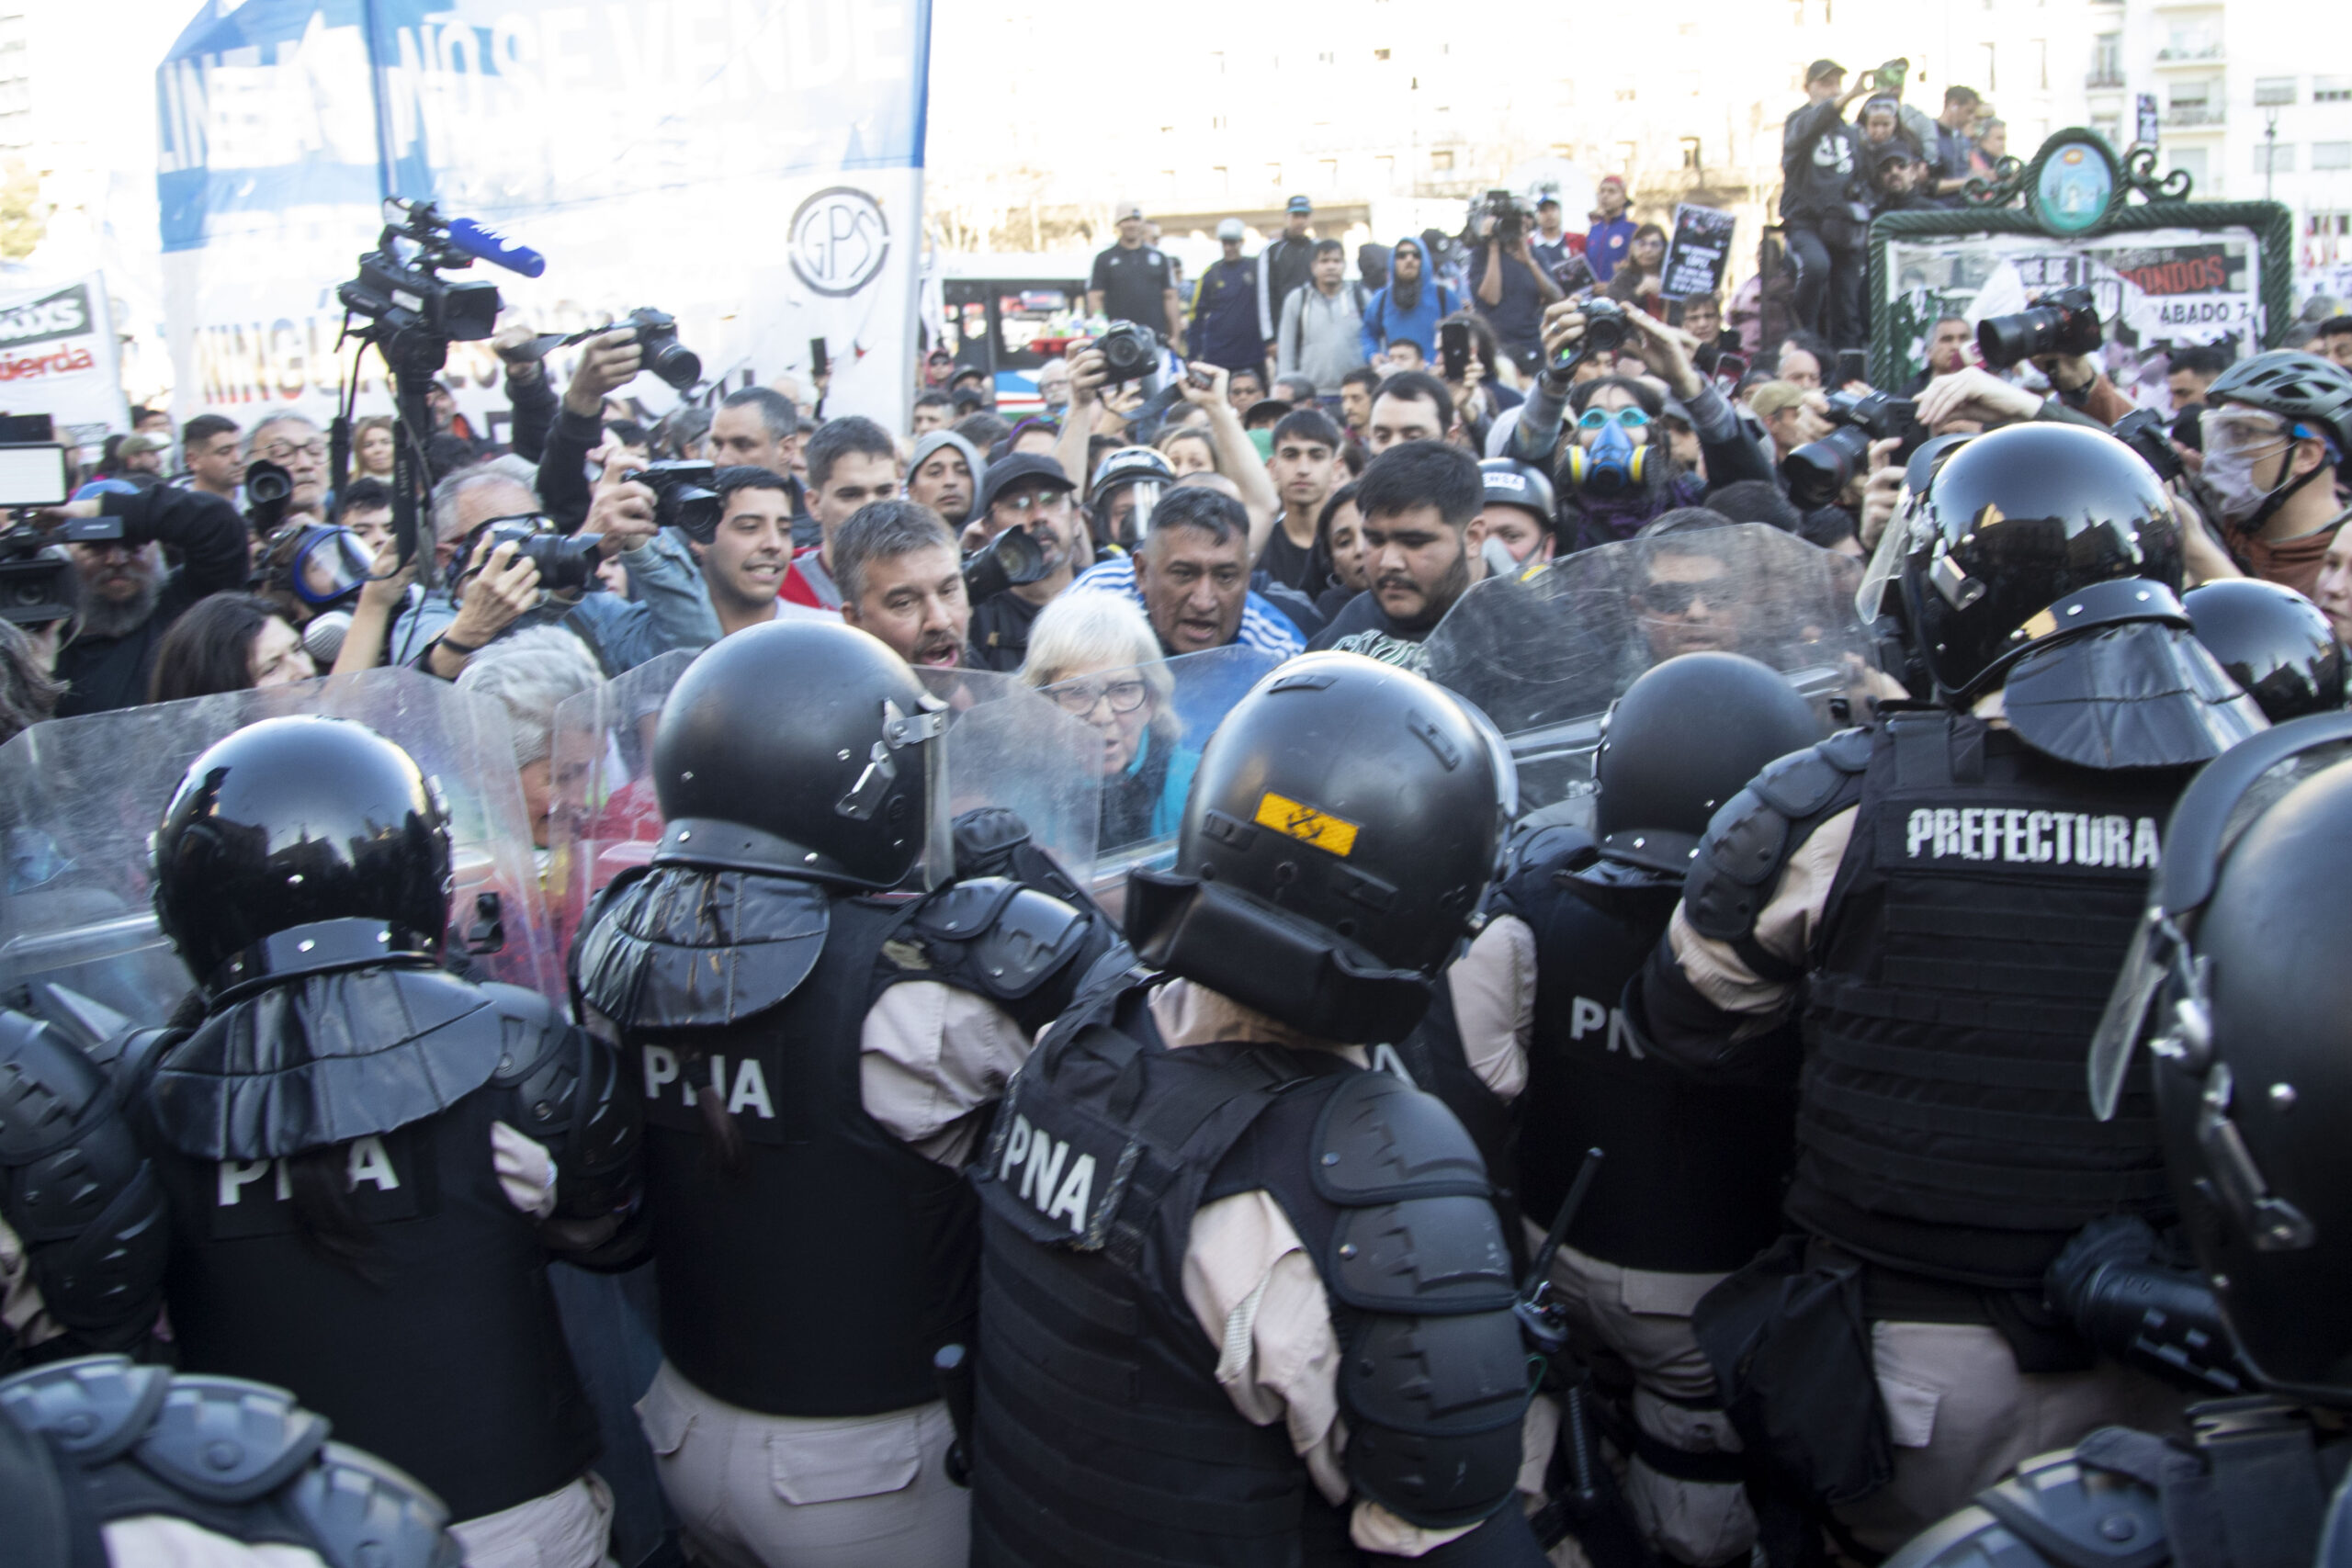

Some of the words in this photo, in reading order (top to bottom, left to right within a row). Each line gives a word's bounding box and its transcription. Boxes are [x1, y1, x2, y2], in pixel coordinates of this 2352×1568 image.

[604, 0, 906, 112] VENDE
[799, 203, 879, 281] GPS
[2119, 254, 2226, 296] ONDOS
[2158, 299, 2231, 325] ÁBADO
[1905, 807, 2163, 870] PREFECTURA
[1569, 995, 1645, 1061] PN
[218, 1134, 401, 1207] PA
[998, 1111, 1097, 1235] PNA
